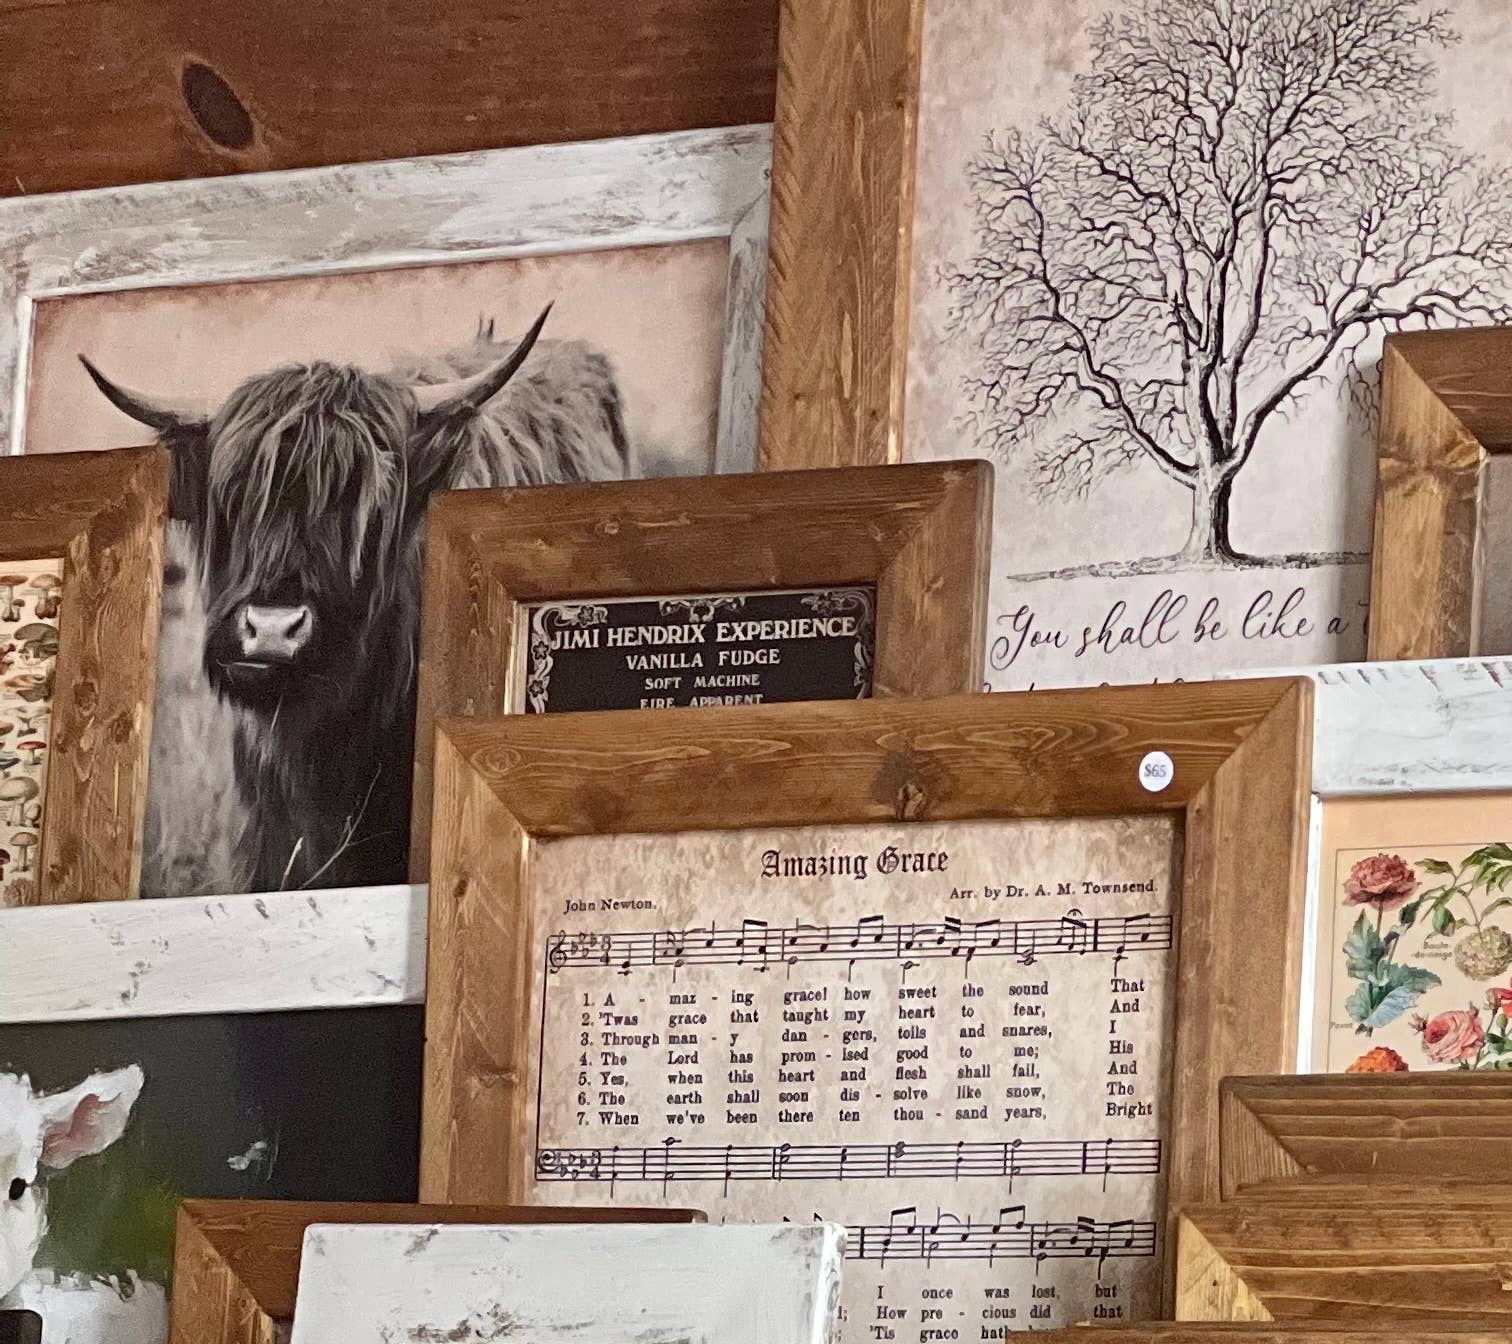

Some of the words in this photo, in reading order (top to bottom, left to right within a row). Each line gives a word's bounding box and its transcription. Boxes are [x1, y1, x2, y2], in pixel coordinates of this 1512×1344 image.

[551, 628, 599, 650] JIMI
[606, 623, 705, 647] HENDRIX
[716, 617, 856, 643] EXPERIENCE
[990, 605, 1068, 671] You
[1075, 589, 1187, 658] shall
[1194, 598, 1230, 643] be
[1242, 588, 1314, 640] like
[1327, 616, 1350, 634] a
[626, 654, 703, 670] VANILLA
[719, 649, 780, 666] FUDGE
[645, 677, 681, 690] SOFT
[695, 674, 760, 687] MACHINE
[1144, 763, 1166, 777] $65
[761, 848, 868, 880] Amazing
[877, 846, 949, 875] Grace
[949, 887, 978, 900] Arr.
[984, 885, 1002, 901] by
[1005, 885, 1029, 898] Dr.
[1034, 884, 1051, 897] A.
[1056, 882, 1076, 896] M.
[1081, 878, 1159, 895] Townsend.
[562, 899, 596, 916] John
[599, 898, 657, 912] Newton.
[603, 992, 616, 1007] A
[669, 994, 697, 1005] maz
[731, 989, 755, 1007] ing
[783, 986, 828, 1006] grace!
[844, 986, 872, 1001] how
[898, 985, 937, 1000] sweet
[962, 982, 984, 998] the
[1008, 980, 1049, 997] sound
[1110, 978, 1145, 993] That
[598, 1011, 639, 1027] 'Twas
[668, 1013, 707, 1029] grace
[730, 1009, 759, 1024] that
[782, 1007, 829, 1026] taught
[843, 1010, 866, 1025] my
[898, 1004, 936, 1020] heart
[961, 1004, 975, 1018] to
[1013, 1001, 1046, 1018] fear,
[1109, 997, 1140, 1014] And
[601, 1031, 660, 1049] Through
[668, 1034, 698, 1045] man
[729, 1033, 739, 1048] y
[781, 1028, 808, 1043] dan
[842, 1029, 877, 1045] gers,
[897, 1024, 927, 1040] toils
[959, 1023, 986, 1038] and
[1001, 1025, 1052, 1039] snares,
[1108, 1019, 1117, 1034] I
[600, 1051, 628, 1066] The
[667, 1050, 699, 1065] Lord
[729, 1049, 754, 1064] has
[780, 1051, 816, 1066] prom
[842, 1046, 869, 1062] ised
[896, 1045, 929, 1064] good
[959, 1045, 973, 1059] to
[1013, 1046, 1039, 1060] me;
[1108, 1039, 1134, 1055] His
[599, 1071, 629, 1087] Yes,
[667, 1070, 703, 1085] when
[727, 1069, 754, 1084] this
[778, 1068, 815, 1083] heart
[840, 1066, 867, 1082] and
[895, 1065, 928, 1081] flesh
[957, 1063, 991, 1080] shall
[1012, 1062, 1040, 1079] fail,
[1107, 1059, 1138, 1075] And
[598, 1091, 626, 1106] The
[666, 1090, 703, 1105] earth
[726, 1089, 760, 1104] shall
[778, 1091, 809, 1104] soon
[839, 1087, 860, 1102] dis
[893, 1086, 929, 1101] solve
[956, 1084, 982, 1100] like
[1005, 1086, 1046, 1100] snow,
[1106, 1080, 1135, 1096] The
[598, 1111, 639, 1126] When
[666, 1109, 705, 1125] we've
[726, 1109, 758, 1124] been
[778, 1108, 814, 1123] there
[838, 1109, 860, 1122] ten
[893, 1106, 924, 1121] thou
[955, 1104, 989, 1121] sand
[1003, 1107, 1047, 1123] years,
[1105, 1101, 1153, 1120] Bright
[877, 1285, 884, 1300] I
[921, 1288, 953, 1300] once
[984, 1287, 1010, 1299] was
[1095, 1283, 1118, 1299] but
[876, 1305, 908, 1320] How
[920, 1309, 943, 1323] pre
[982, 1304, 1017, 1319] cious
[1029, 1304, 1052, 1319] did
[1093, 1303, 1124, 1319] that
[869, 1324, 896, 1340] 'Tis
[919, 1328, 959, 1344] grace
